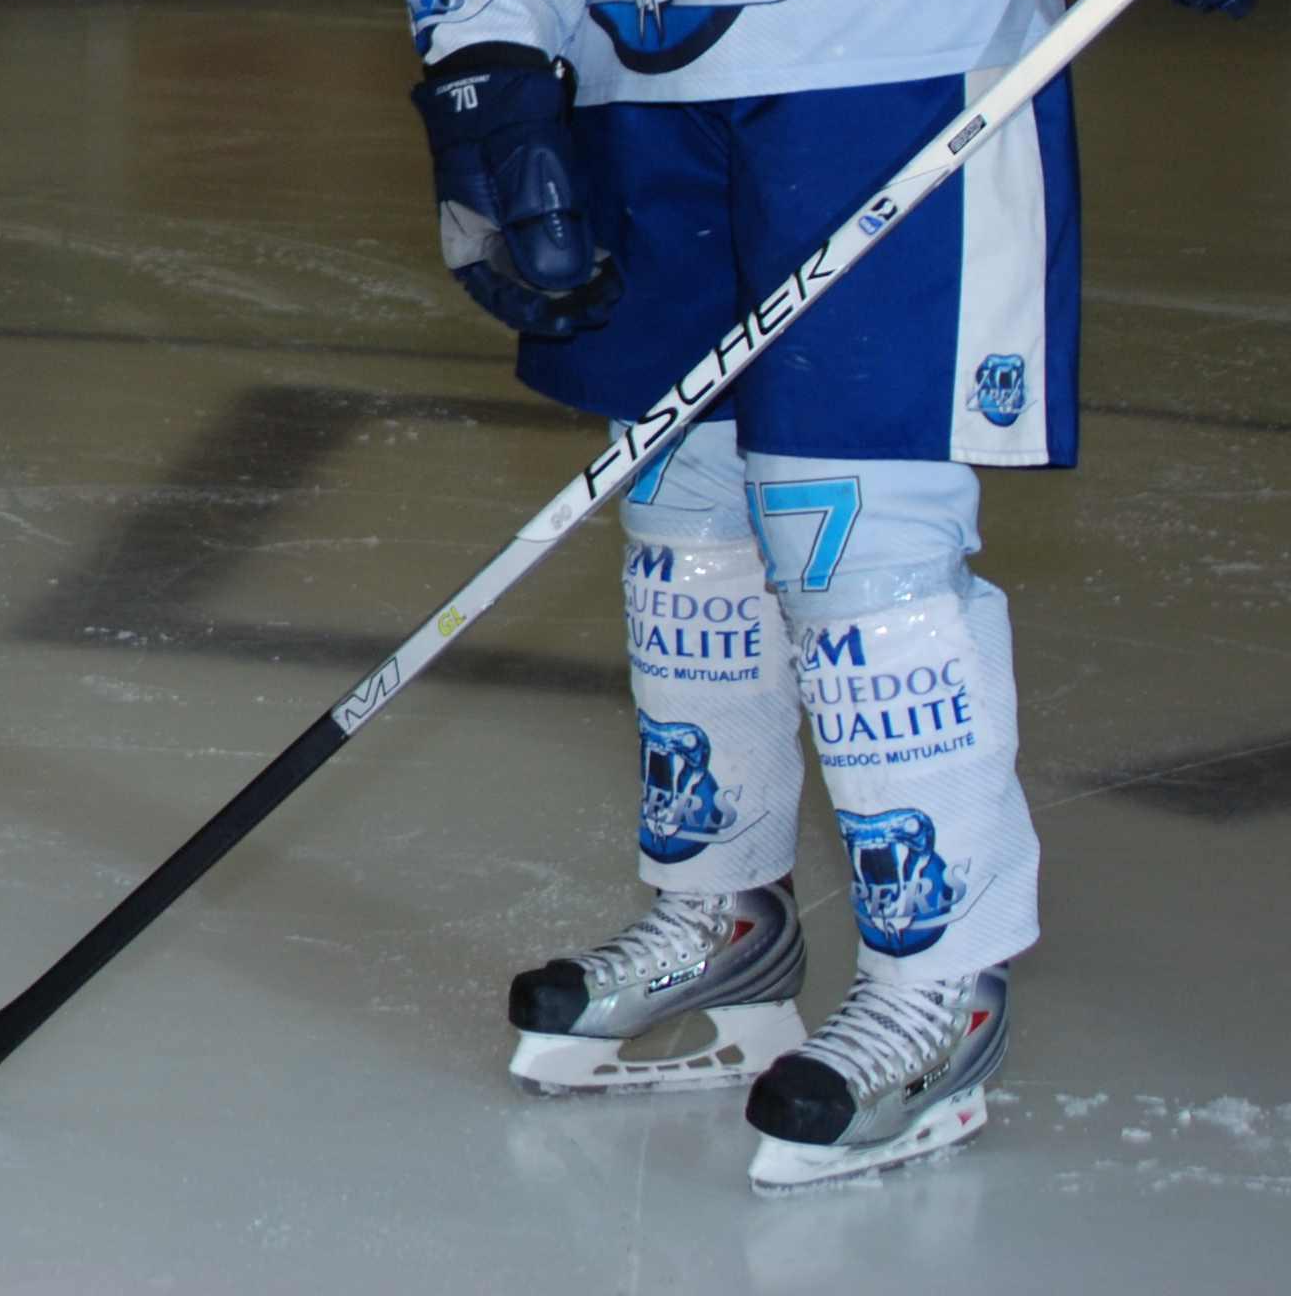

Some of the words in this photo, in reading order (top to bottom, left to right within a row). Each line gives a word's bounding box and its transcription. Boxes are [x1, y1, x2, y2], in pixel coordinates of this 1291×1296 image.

[451, 84, 479, 113] 70
[579, 238, 836, 501] FISCHER
[759, 475, 863, 592] 7
[627, 616, 762, 660] UALITÉ
